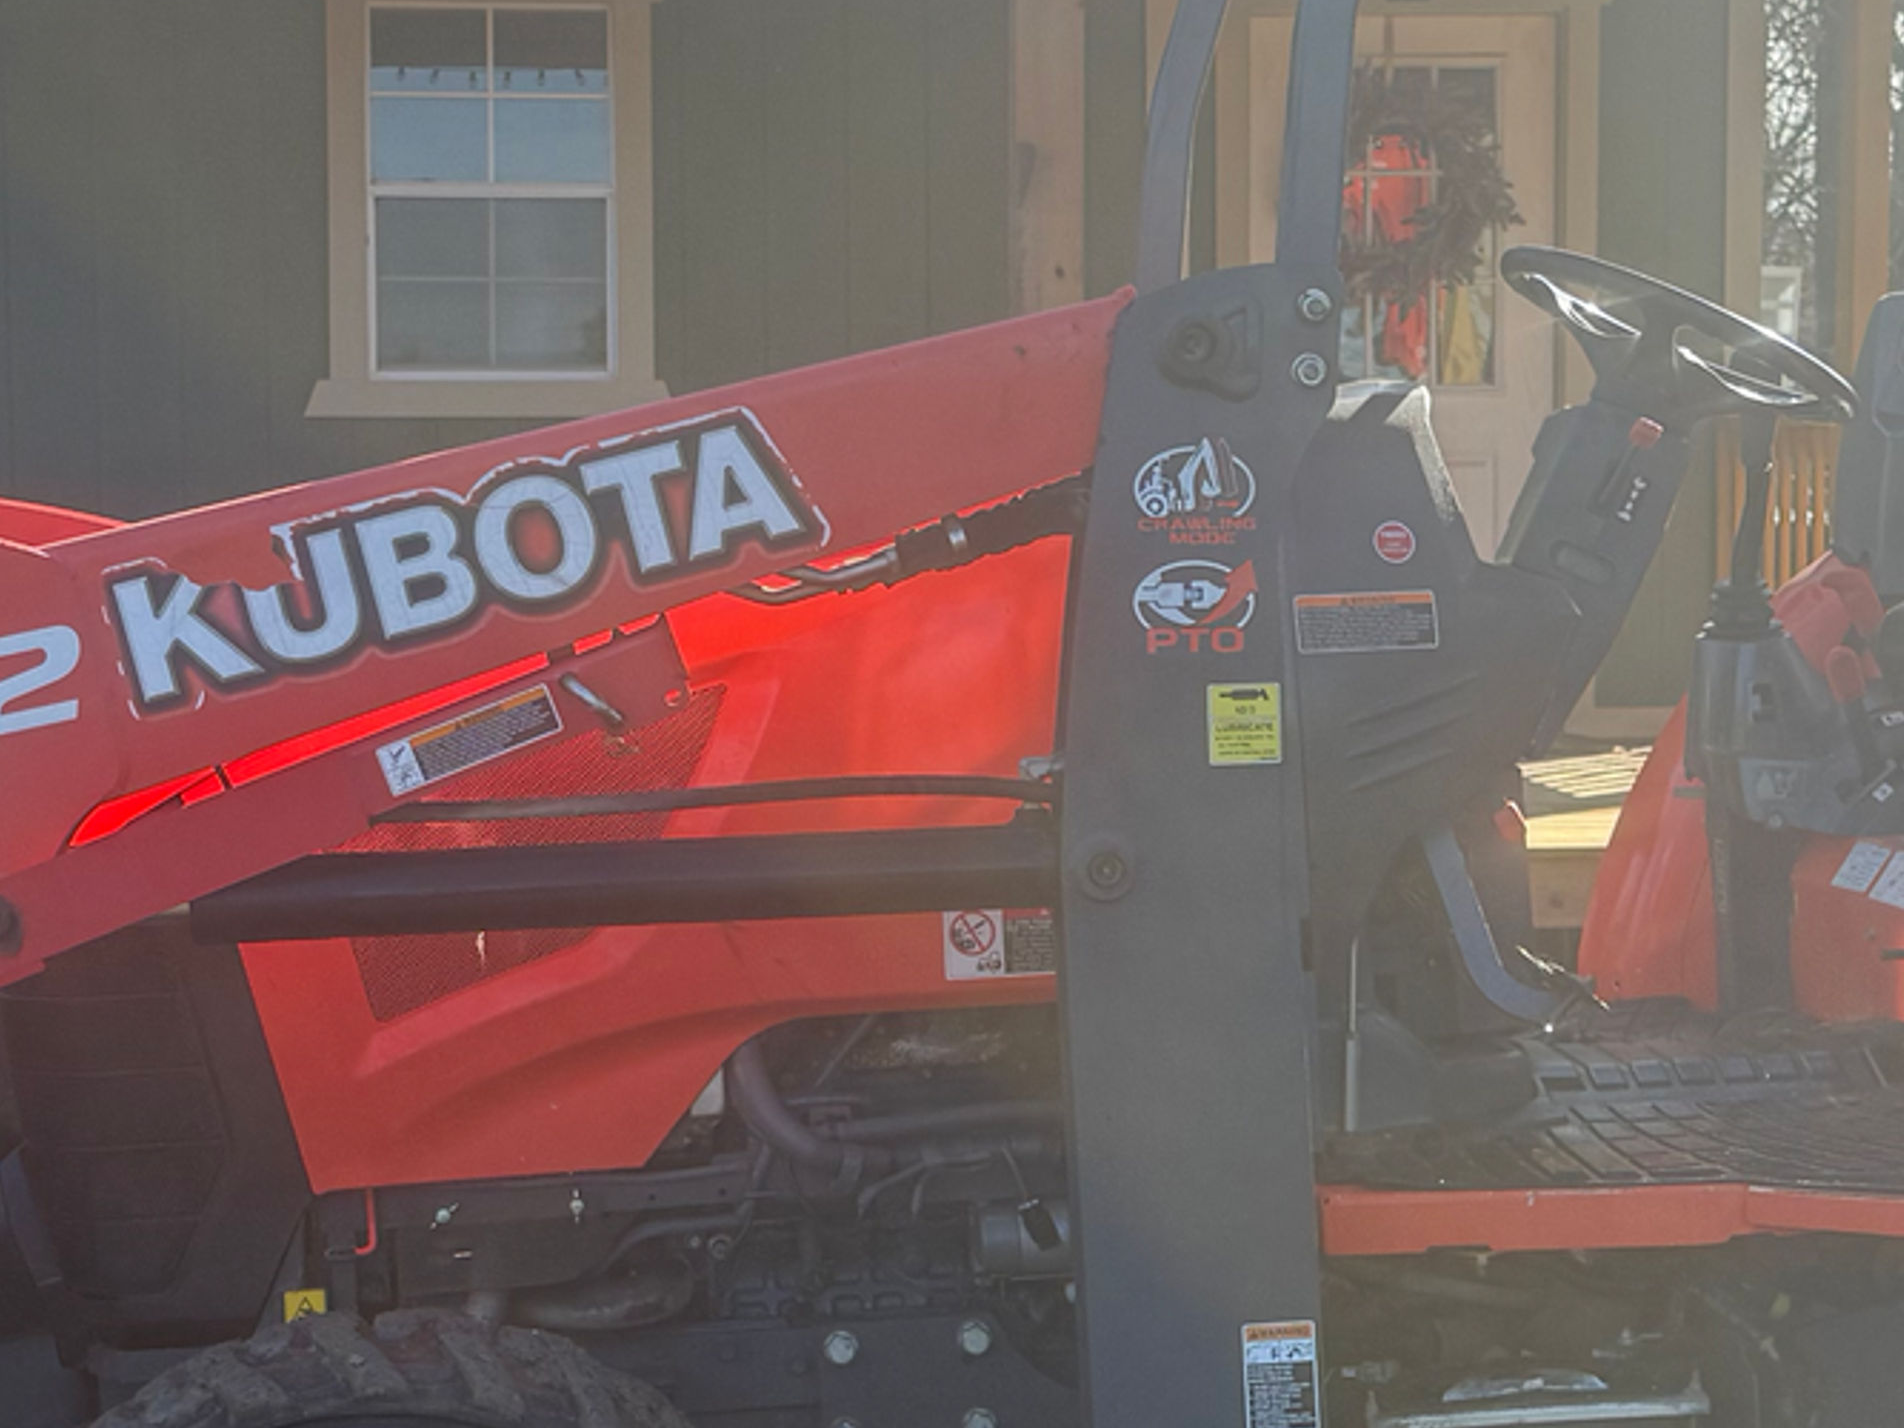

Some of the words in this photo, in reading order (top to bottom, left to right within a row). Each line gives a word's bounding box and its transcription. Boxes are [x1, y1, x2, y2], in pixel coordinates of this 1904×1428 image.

[1136, 515, 1257, 532] CRAWLING
[1168, 531, 1236, 545] MODE
[109, 422, 802, 706] KUBOTA
[1146, 626, 1245, 654] PTO
